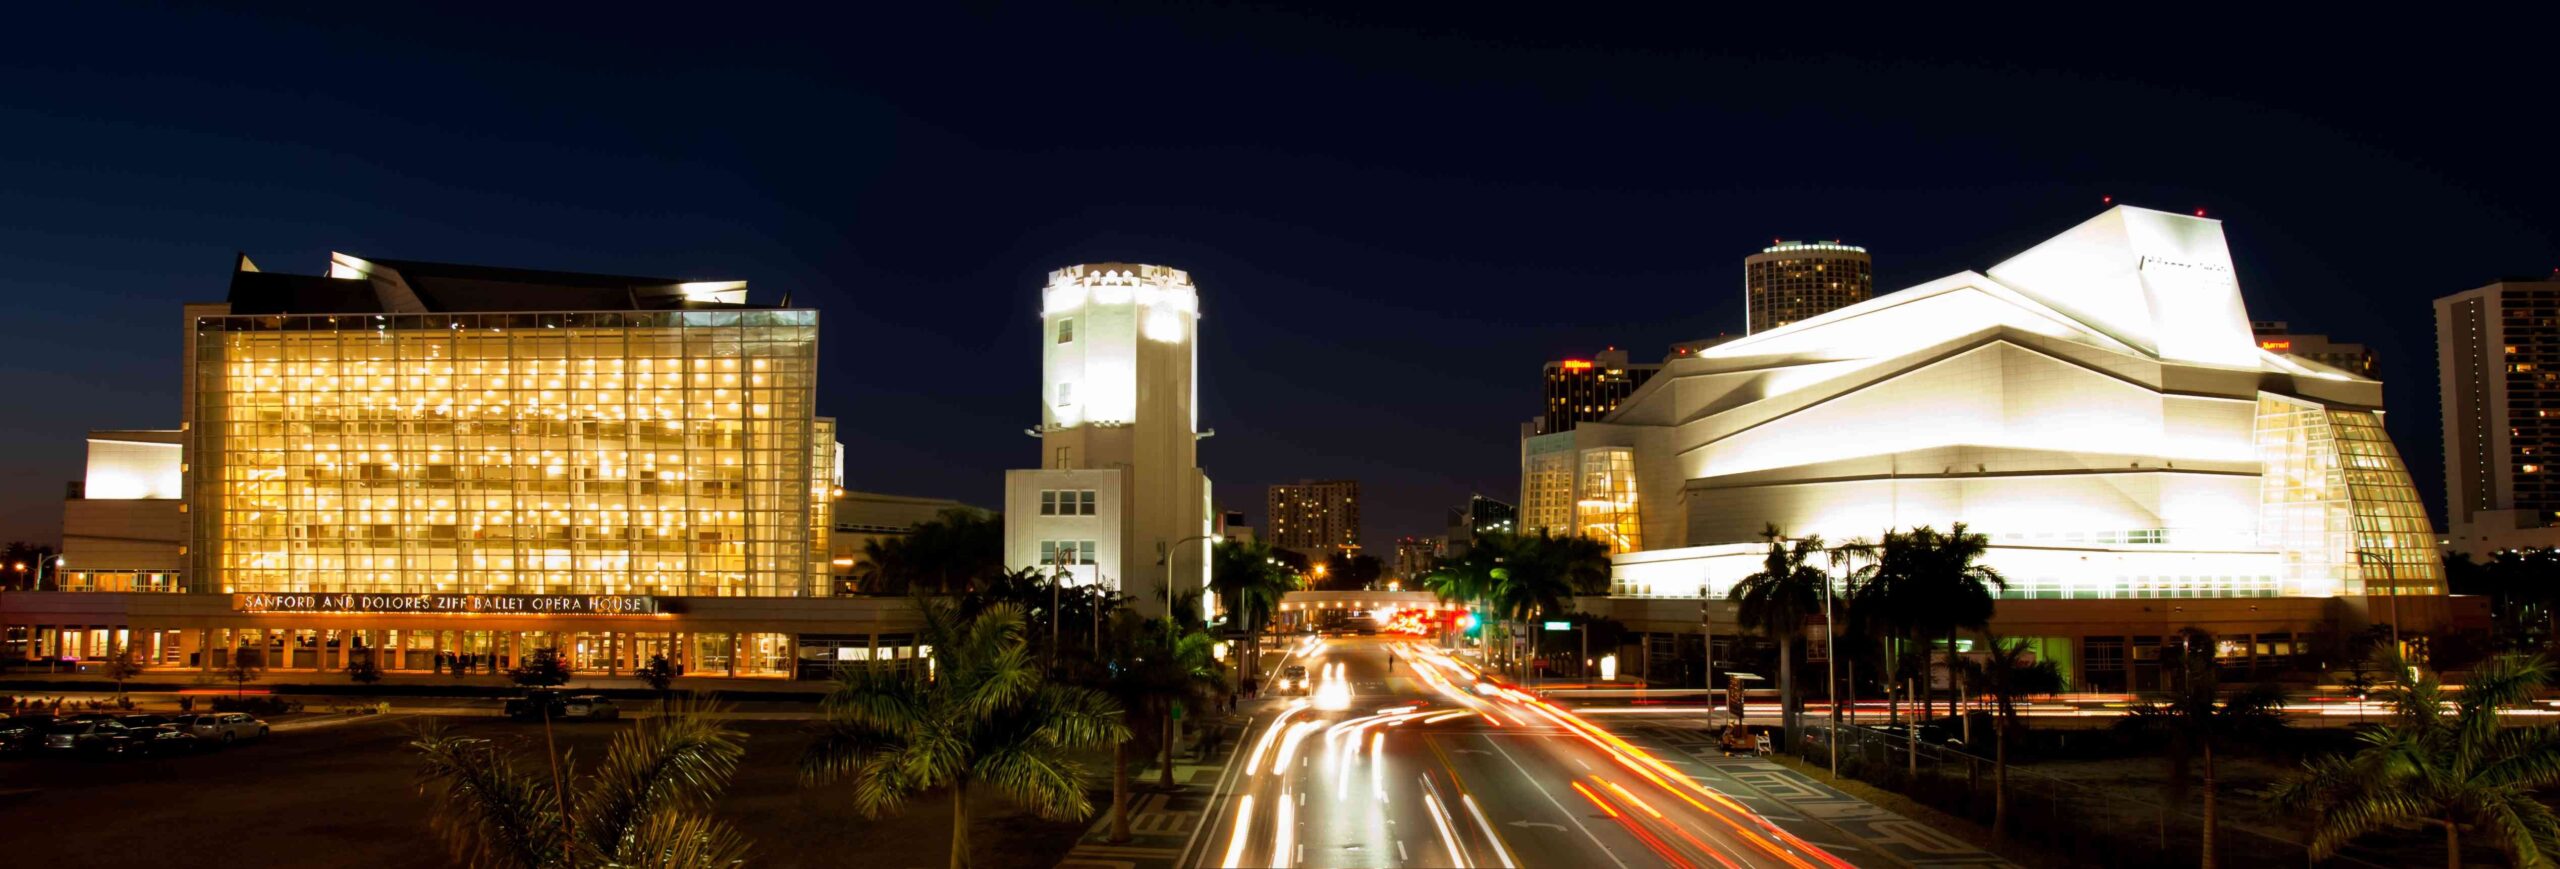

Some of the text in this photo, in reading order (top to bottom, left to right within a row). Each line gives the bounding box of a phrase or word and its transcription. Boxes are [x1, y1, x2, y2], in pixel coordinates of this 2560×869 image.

[244, 595, 642, 610] SANFORD AND DOLORES ZIFF BALLET OPERA HOUSE
